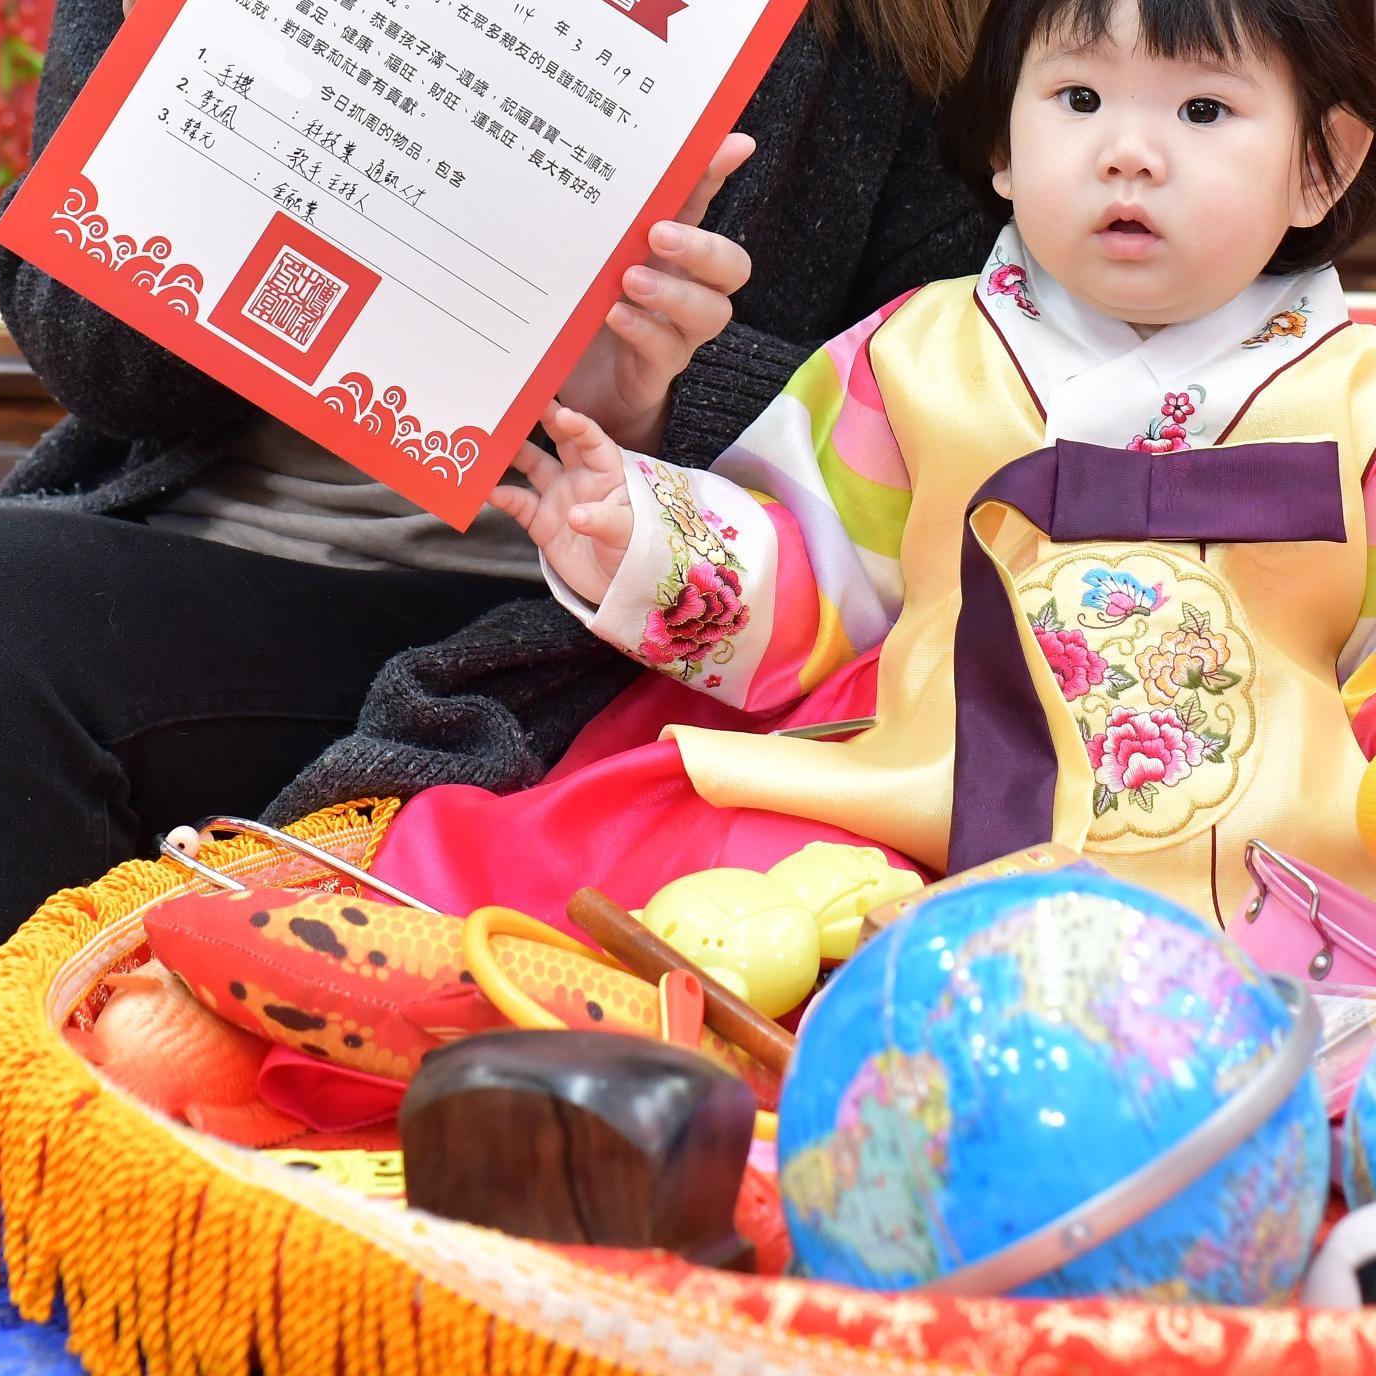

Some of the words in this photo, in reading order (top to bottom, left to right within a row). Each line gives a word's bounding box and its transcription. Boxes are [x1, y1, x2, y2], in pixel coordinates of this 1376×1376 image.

[513, 3, 534, 22] 114
[554, 20, 570, 36] 年
[571, 38, 582, 51] 3
[595, 48, 612, 65] 月
[613, 66, 630, 84] 19
[639, 76, 654, 93] 日
[320, 85, 465, 188] 今日抓周的物品，包含
